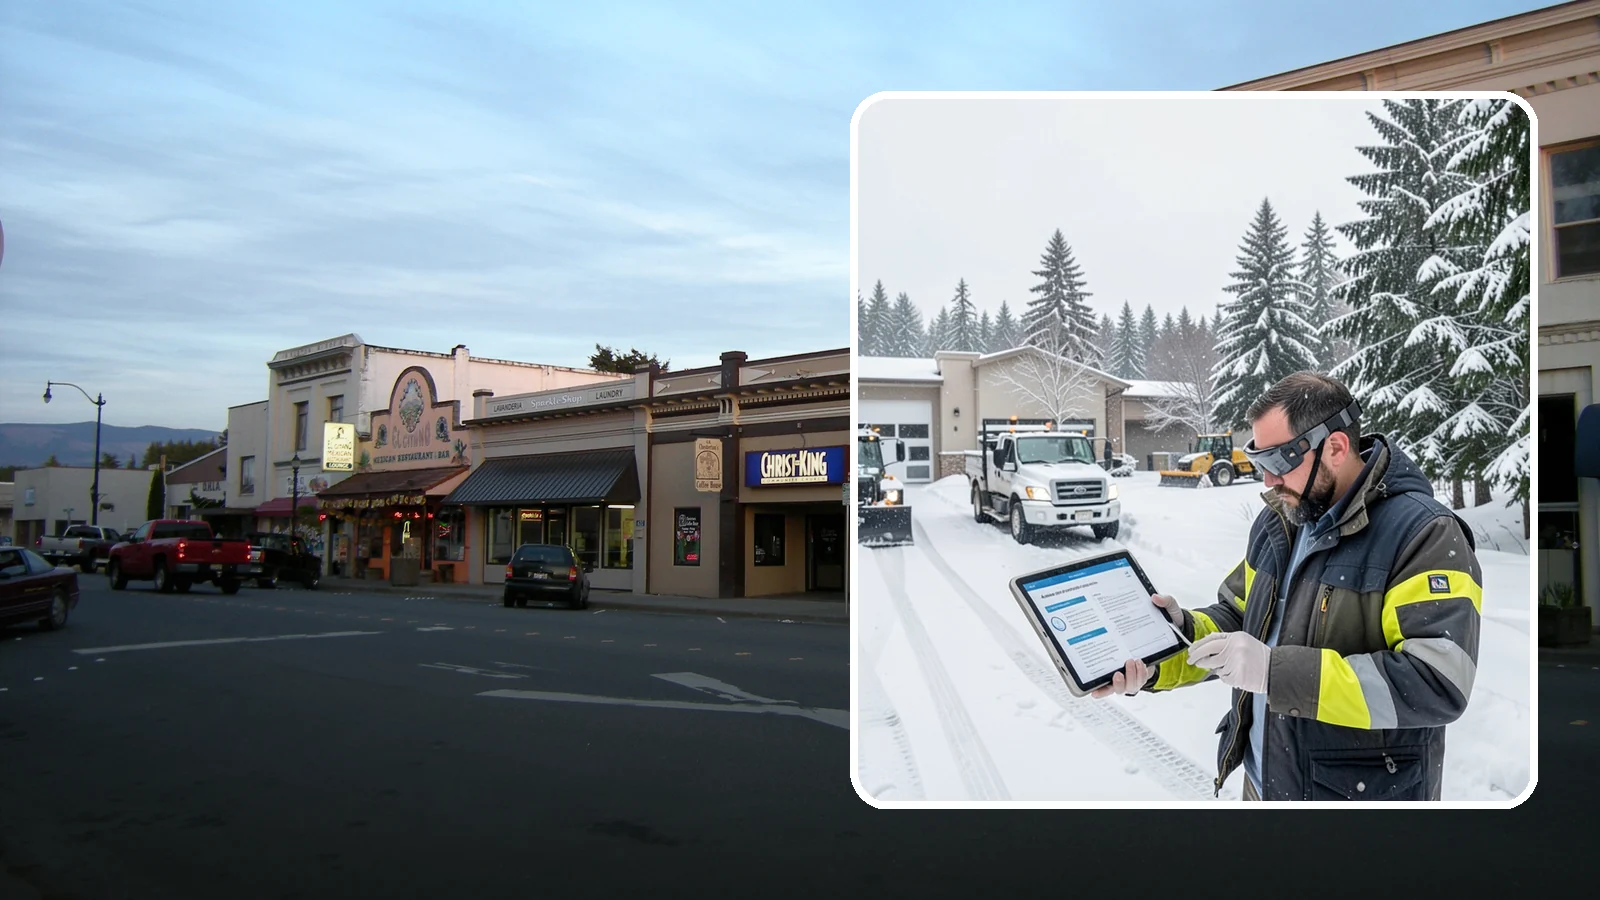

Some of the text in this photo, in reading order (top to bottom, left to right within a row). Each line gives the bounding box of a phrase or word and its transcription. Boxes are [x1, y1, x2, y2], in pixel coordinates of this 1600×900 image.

[595, 389, 624, 400] LAUNDRY
[493, 402, 523, 413] LAVANDERIA
[531, 394, 583, 410] Sparkle Shop
[373, 455, 396, 464] MEXICAN
[397, 451, 433, 462] RESTAURANT
[438, 450, 450, 459] BAR
[761, 450, 828, 478] CHRIST KING
[710, 480, 721, 489] House
